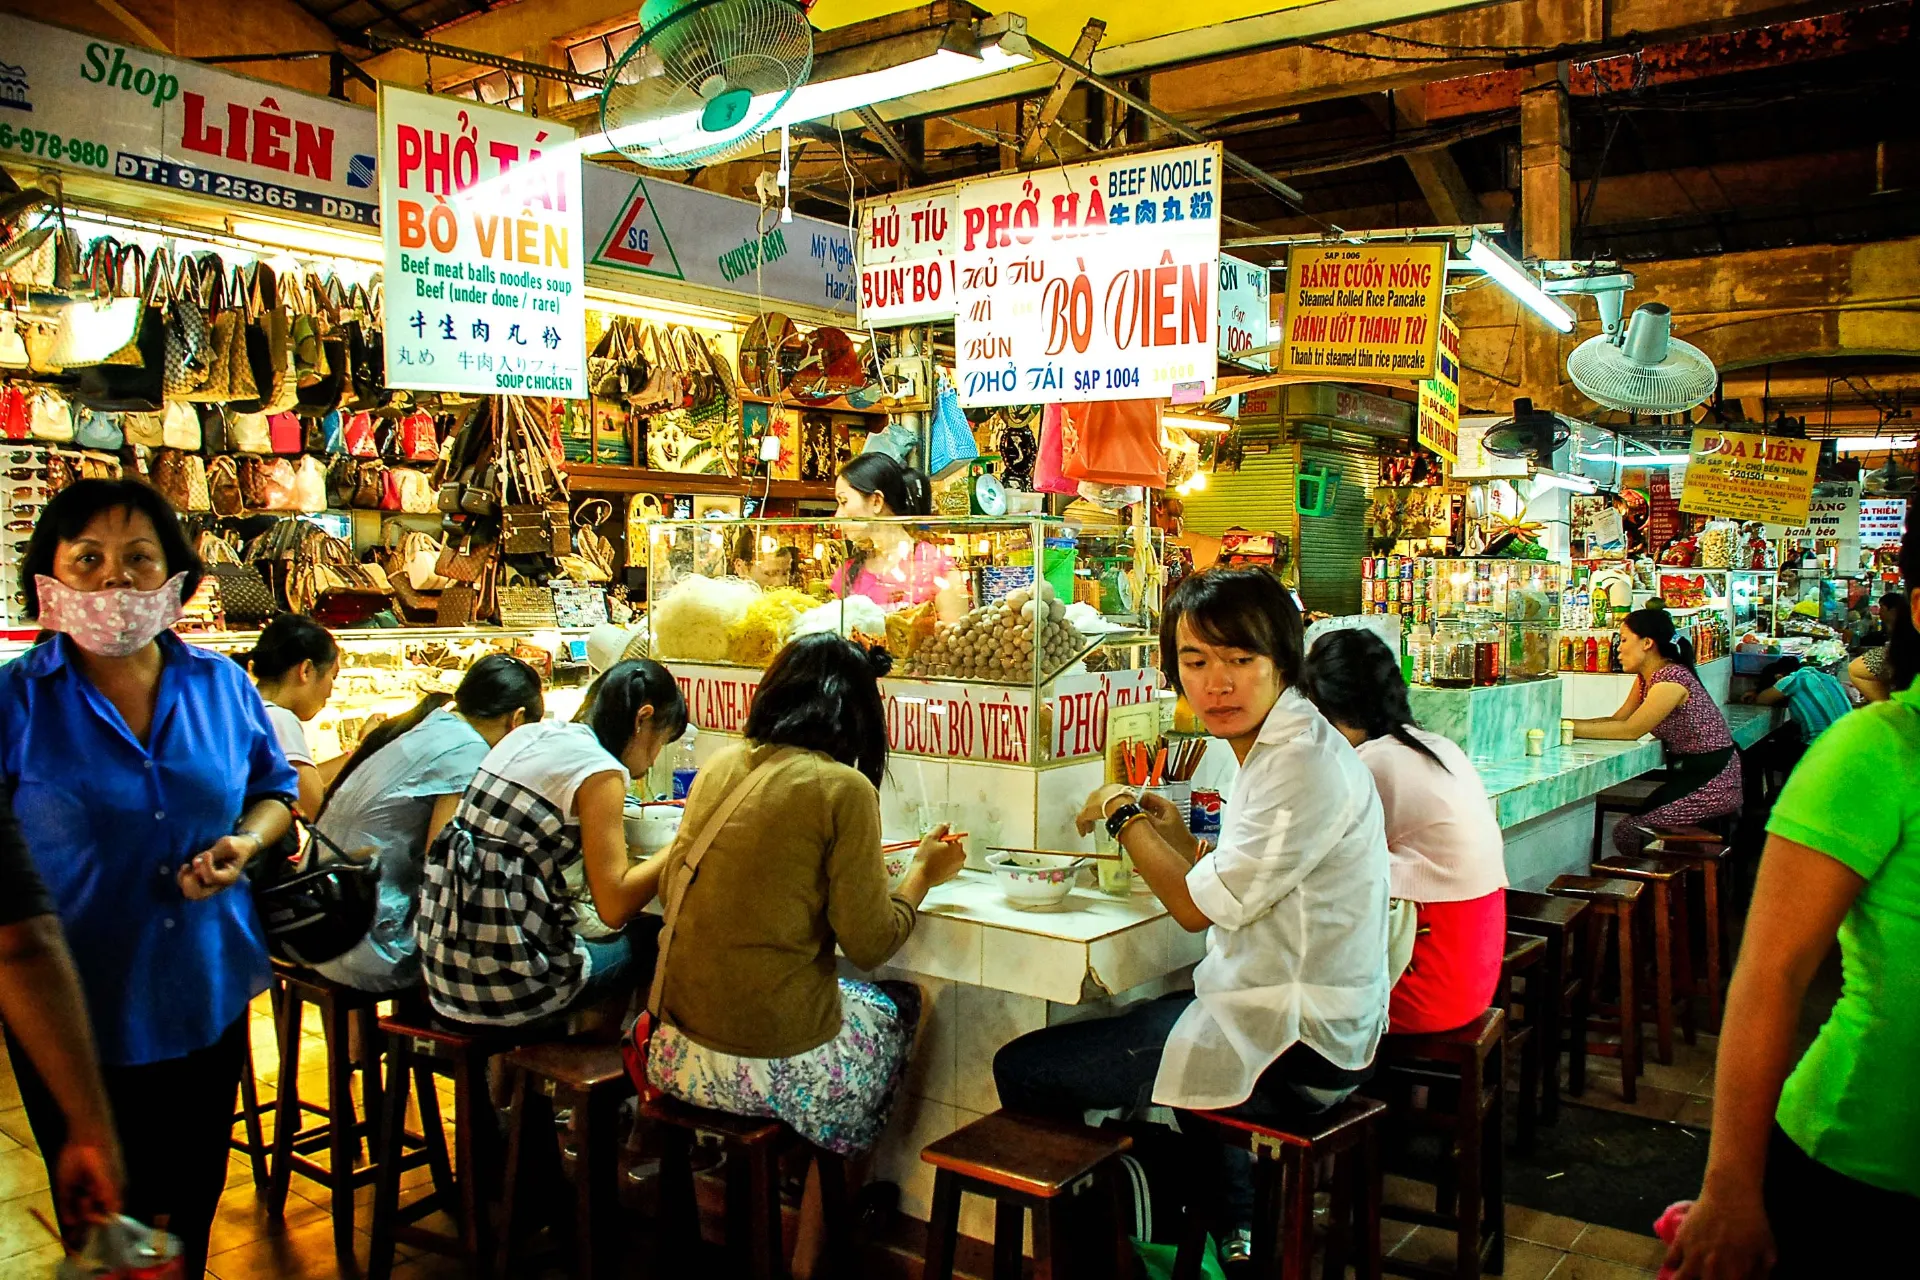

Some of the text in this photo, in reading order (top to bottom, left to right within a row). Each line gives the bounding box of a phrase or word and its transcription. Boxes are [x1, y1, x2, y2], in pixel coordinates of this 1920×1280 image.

[81, 43, 179, 108] Shop
[182, 91, 335, 182] LIÊN
[397, 110, 479, 197] PHỞ
[116, 154, 169, 184] ĐT:
[179, 171, 297, 210] 9125365
[1108, 157, 1213, 199] BEEF NOODLE
[963, 175, 1109, 252] PHỞ HÀ
[1109, 190, 1214, 226] 牛肉丸粉
[398, 194, 570, 270] BÒ VIÊN
[628, 226, 650, 252] SG
[872, 204, 900, 250] HỦ
[1299, 256, 1432, 289] BÁNH CUỐN NÓNG
[1341, 252, 1361, 260] 1006
[401, 253, 572, 297] Beef meat balls noodles soup
[912, 249, 942, 303] BÒ
[416, 278, 445, 300] Beef
[449, 284, 487, 306] (under
[491, 288, 520, 310] done
[532, 295, 561, 315] rare)
[1041, 249, 1209, 357] BÒ VIÊN
[1299, 289, 1426, 308] Steamed Rolled Rice Pancake
[409, 309, 562, 351] 牛生肉丸粉
[1228, 325, 1253, 353] 1006
[1291, 310, 1327, 343] BÁNH
[1358, 315, 1402, 344] THANH
[1404, 313, 1428, 345] TRÌ
[963, 332, 1012, 361] BÚN
[1290, 346, 1313, 366] Thanh
[1325, 349, 1358, 368] steamed
[1358, 349, 1374, 367] thin
[1374, 350, 1391, 368] rice
[1391, 352, 1426, 372] pancake
[495, 373, 573, 392] SOUP CHICKEN
[964, 361, 1017, 398] PHỞ
[1024, 361, 1064, 392] TÁI
[1105, 366, 1140, 389] 1004
[1703, 437, 1807, 465] HOA LIÊN
[1729, 469, 1765, 481] 5201501
[1809, 501, 1847, 512] UẢNG
[948, 689, 974, 758] BÒ
[978, 692, 1029, 763] VIÊN
[1056, 673, 1112, 758] PHỞ
